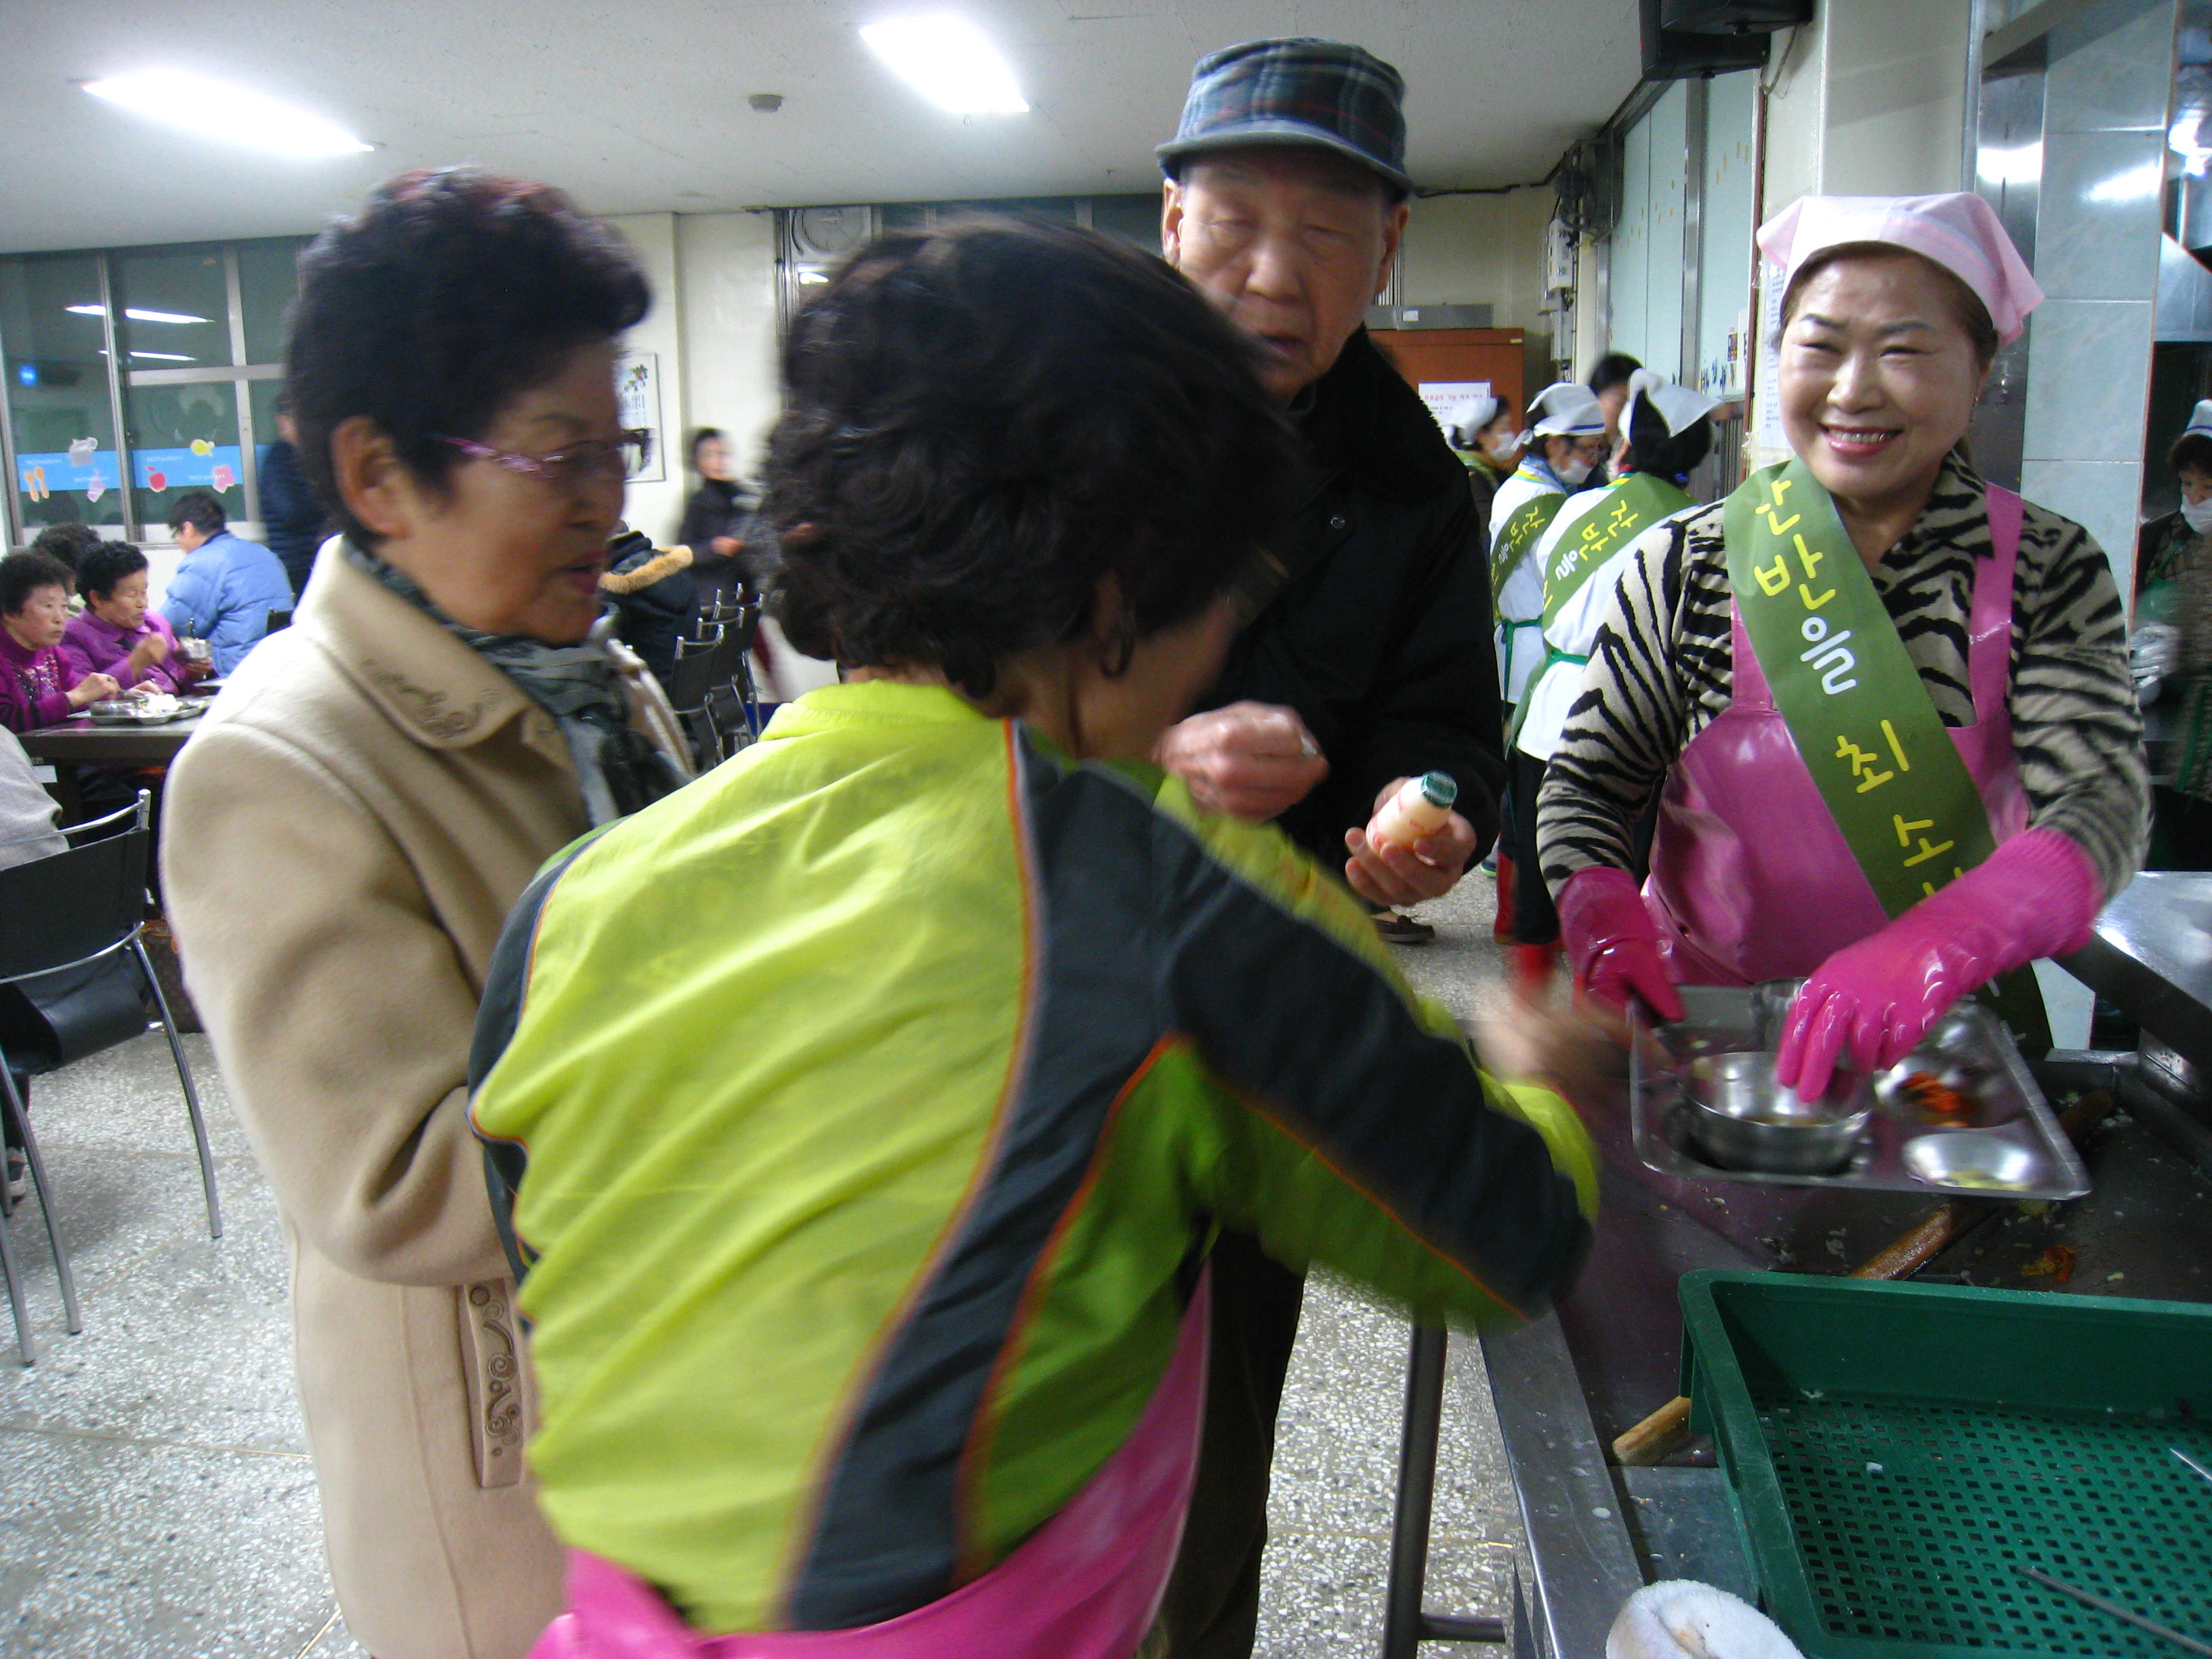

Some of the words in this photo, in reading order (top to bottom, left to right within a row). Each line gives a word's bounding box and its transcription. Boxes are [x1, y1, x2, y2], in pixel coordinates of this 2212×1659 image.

[1498, 506, 1546, 565] 잔반은
[1555, 499, 1639, 581] 잔반은
[1836, 719, 1963, 898] 최소
